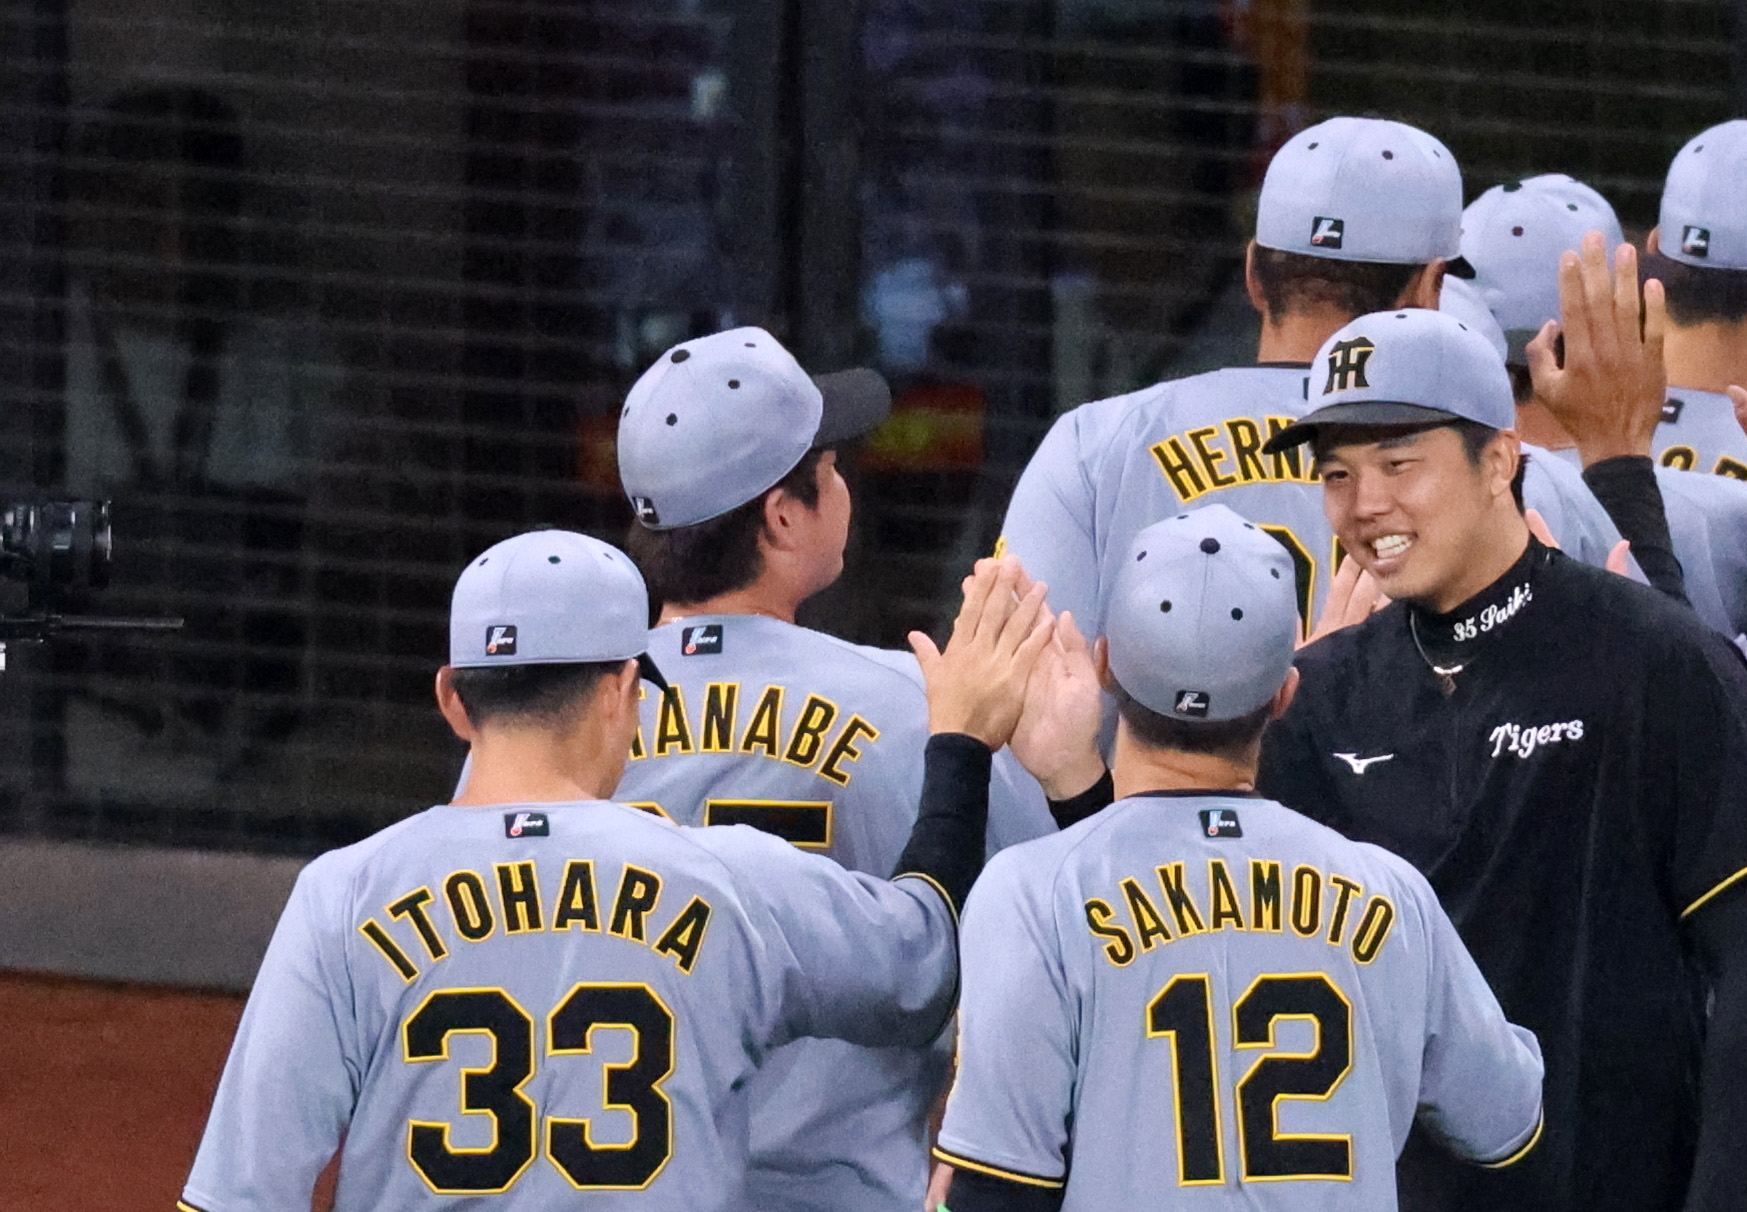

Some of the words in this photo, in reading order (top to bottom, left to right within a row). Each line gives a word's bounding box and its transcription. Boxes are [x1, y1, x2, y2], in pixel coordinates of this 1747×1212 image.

[1149, 415, 1323, 503] HERN
[1453, 617, 1478, 641] 35
[1480, 582, 1533, 632] Saiki
[1489, 719, 1584, 759] Tigers
[358, 859, 713, 985] ITOHARA
[1084, 858, 1396, 968] SAKAMOTO
[401, 980, 677, 1196] 33
[1145, 971, 1354, 1188] 12
